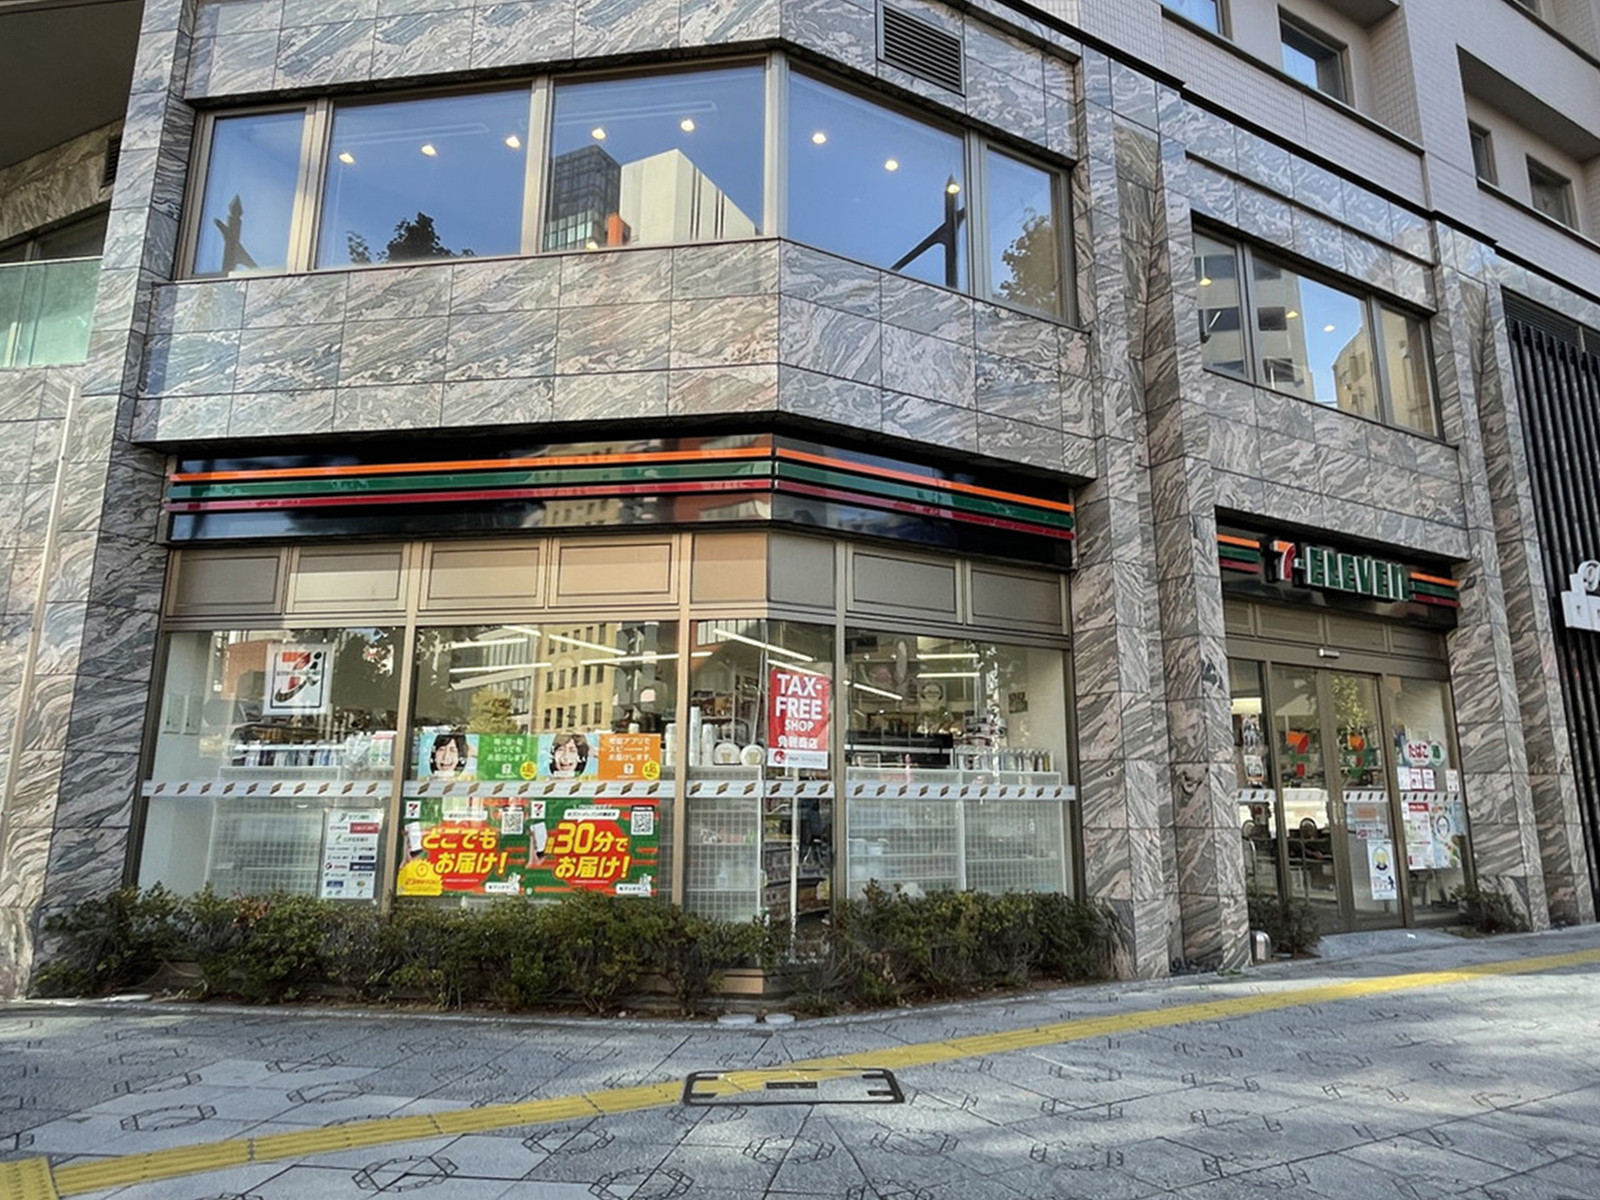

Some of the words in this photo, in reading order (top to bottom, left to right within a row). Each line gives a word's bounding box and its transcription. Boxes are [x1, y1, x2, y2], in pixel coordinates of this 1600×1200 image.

[776, 673, 822, 697] TAX-
[775, 696, 822, 719] FREE
[785, 719, 814, 731] SHOP
[422, 828, 497, 849] どこでも
